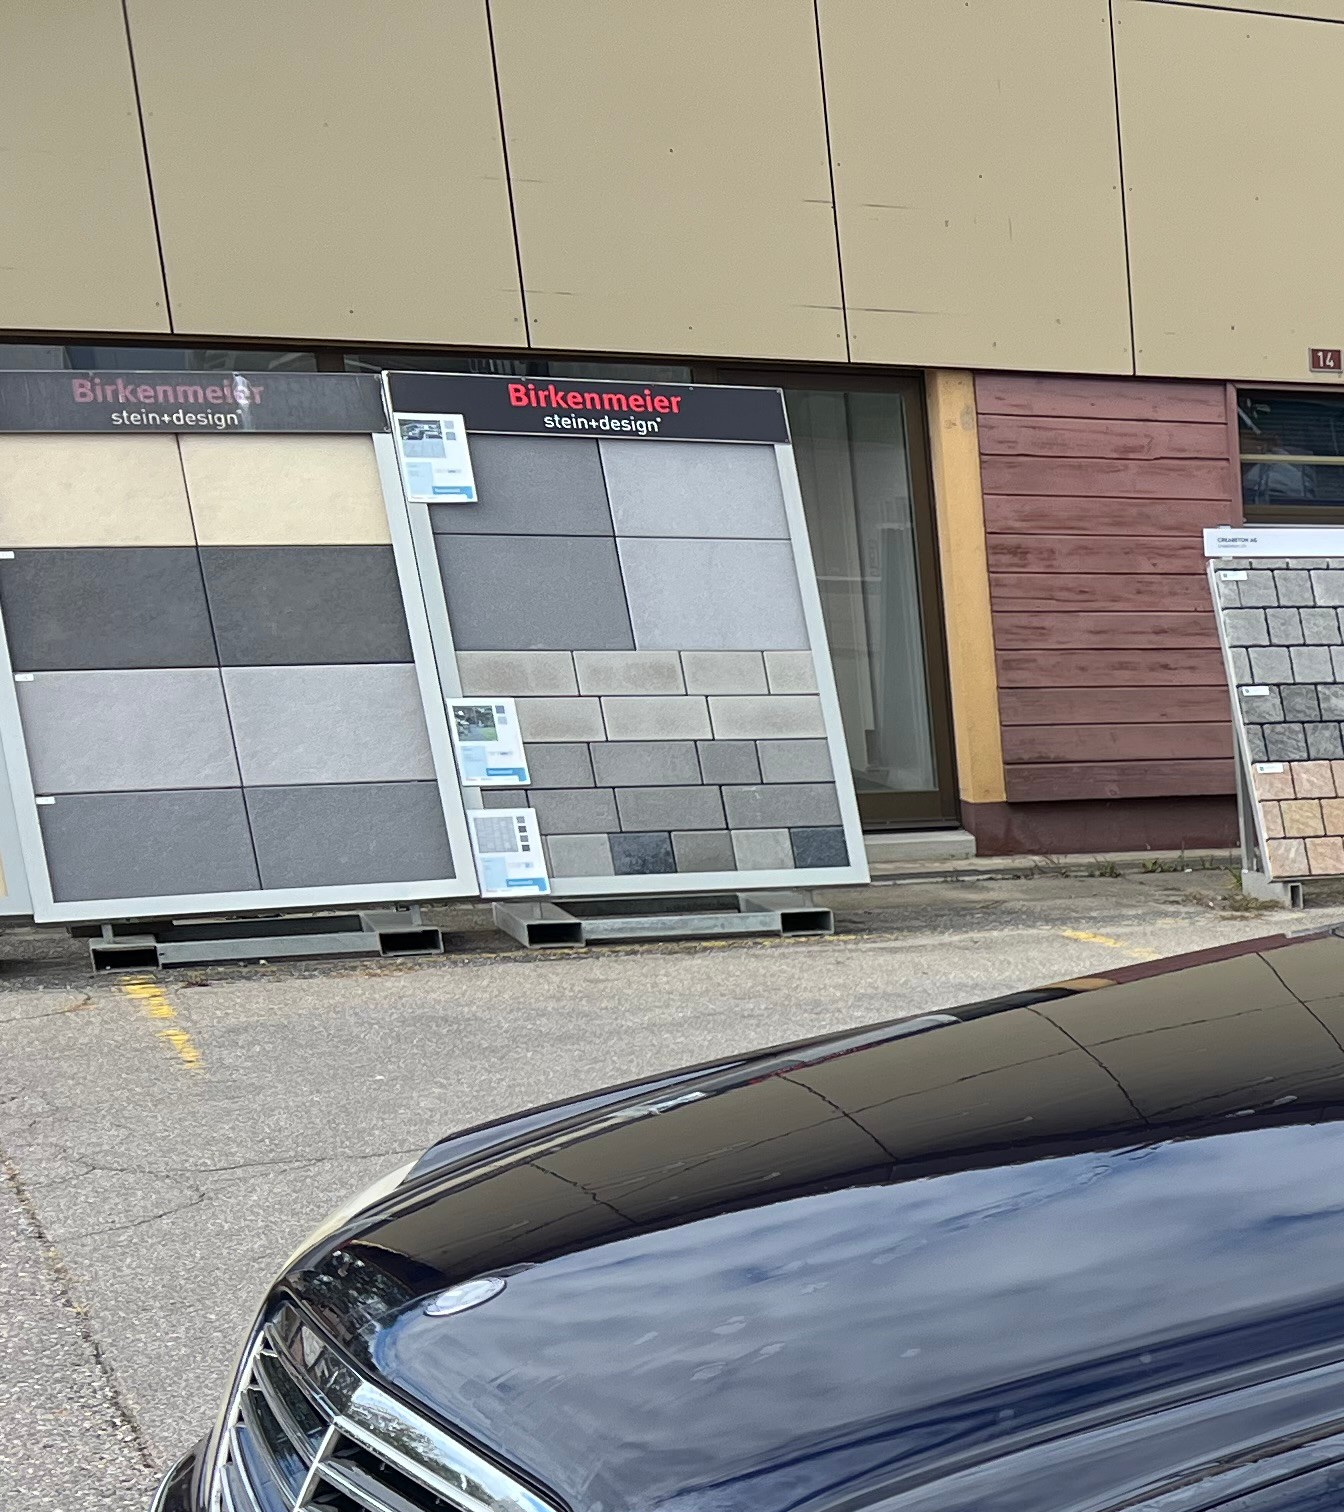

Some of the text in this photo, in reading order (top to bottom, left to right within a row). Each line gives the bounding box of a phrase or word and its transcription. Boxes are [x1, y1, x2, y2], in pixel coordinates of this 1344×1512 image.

[1316, 350, 1336, 368] 14
[71, 377, 265, 405] Birkenmeier
[508, 383, 682, 413] Birkenmeier
